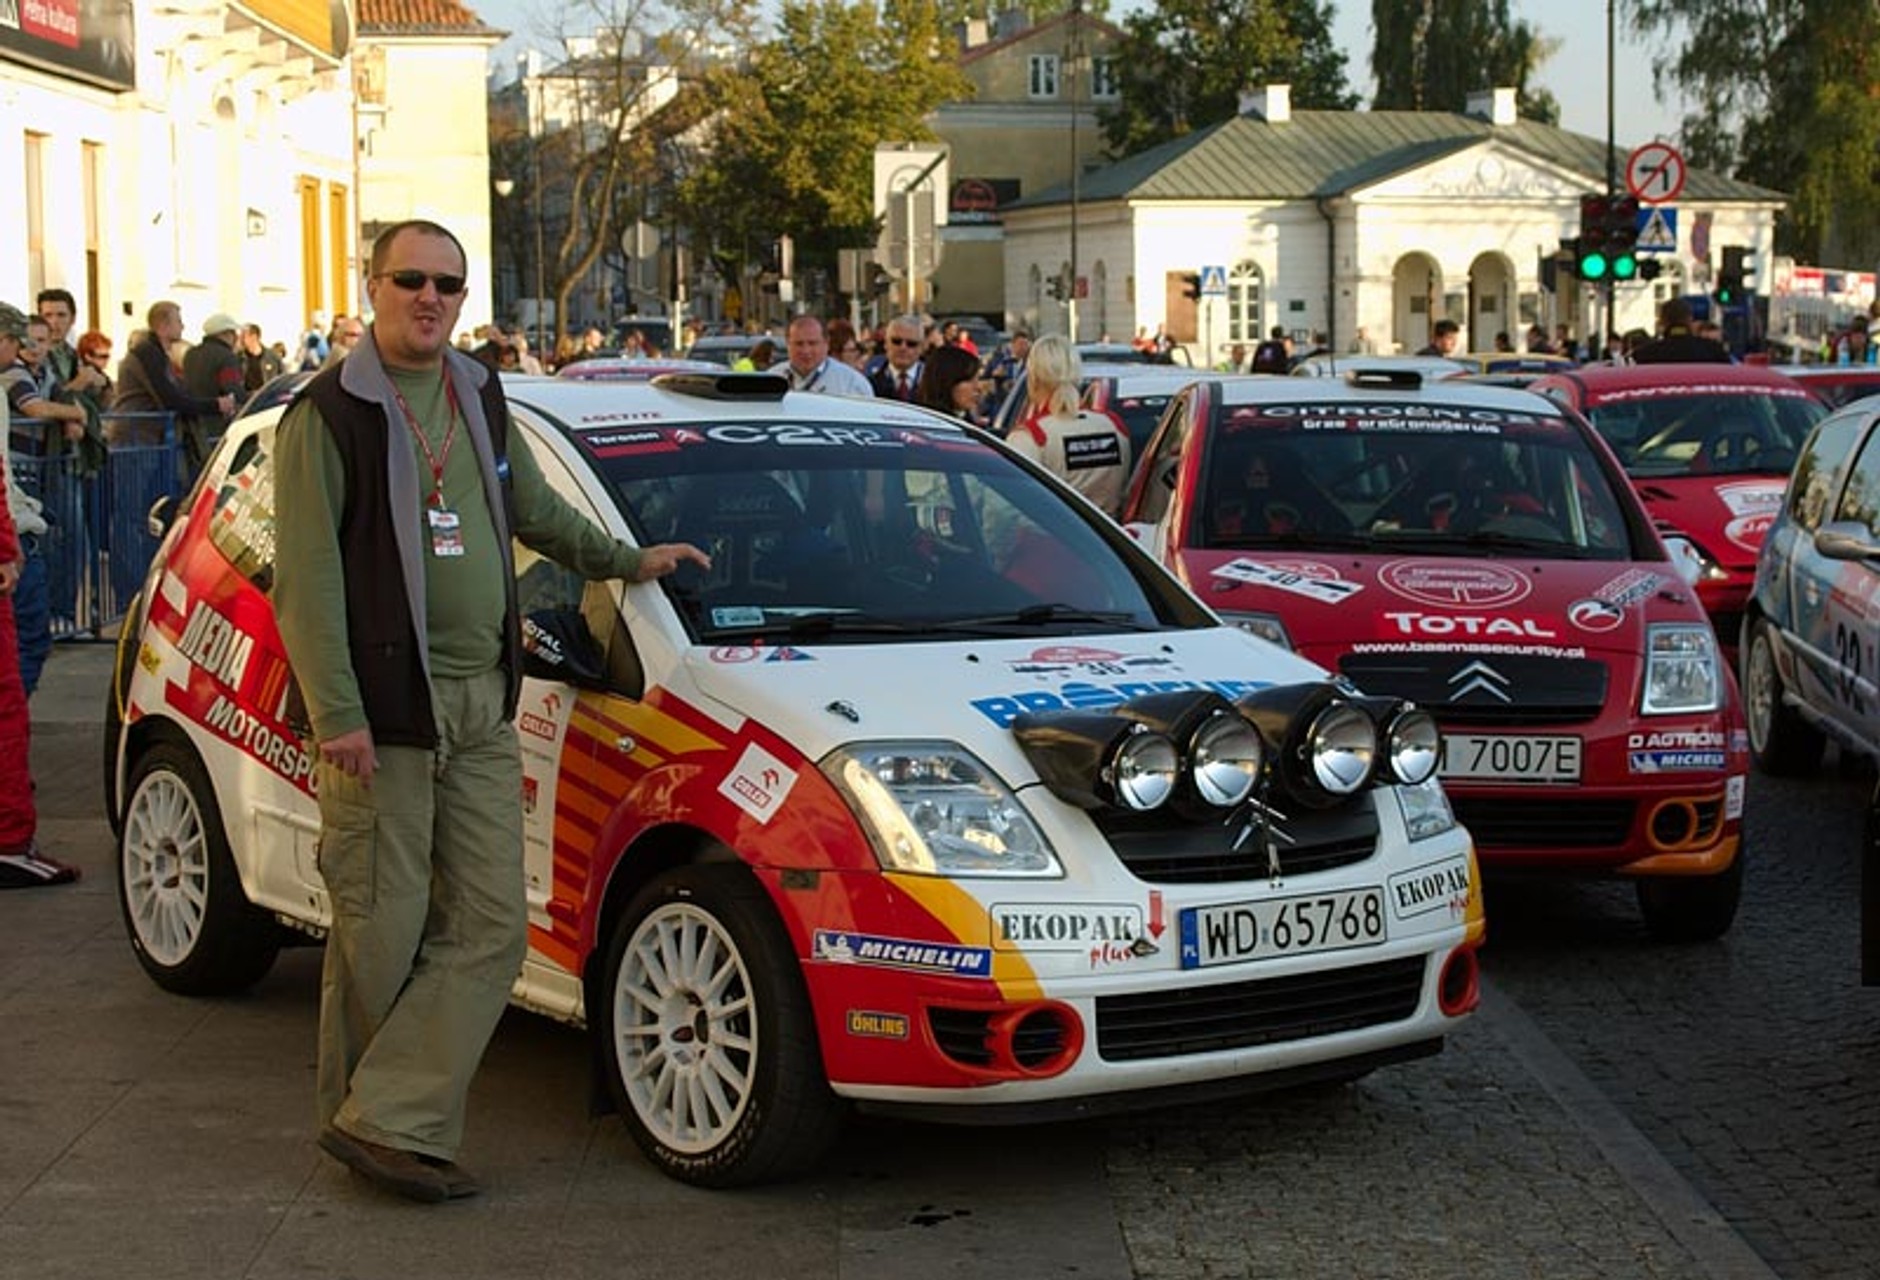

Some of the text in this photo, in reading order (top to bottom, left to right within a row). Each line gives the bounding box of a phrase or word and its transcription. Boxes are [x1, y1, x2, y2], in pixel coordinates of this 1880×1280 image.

[1384, 612, 1556, 638] TOTAL
[176, 600, 255, 692] MEDIA
[1470, 740, 1576, 773] 7007E
[1396, 864, 1469, 908] EKOPAK
[1001, 913, 1133, 942] EKOPAK
[1205, 893, 1382, 959] WD 65768
[859, 940, 984, 969] MICHELIN
[1089, 940, 1132, 969] plus
[851, 1010, 905, 1037] ÖHLINS
